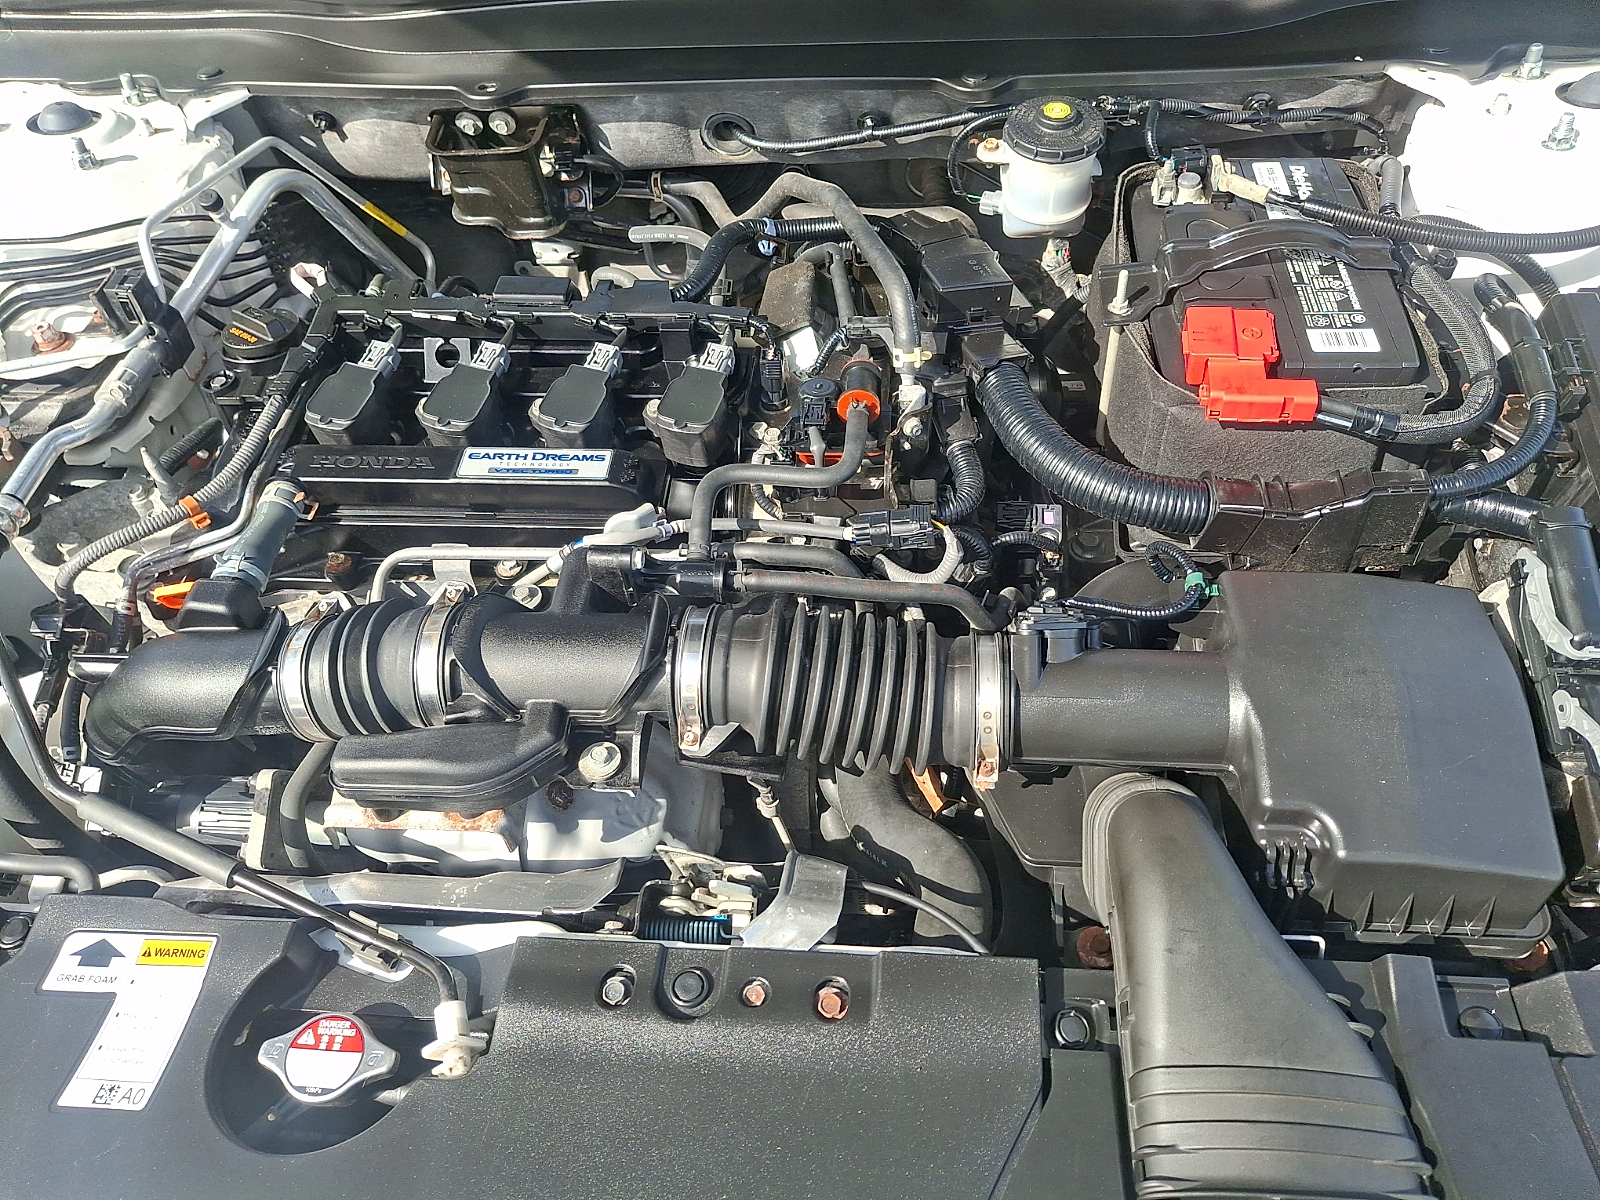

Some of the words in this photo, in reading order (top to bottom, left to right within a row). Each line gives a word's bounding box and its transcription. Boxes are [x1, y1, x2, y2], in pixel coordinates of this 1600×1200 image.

[309, 454, 436, 469] HONDA
[468, 452, 527, 460] EARTH
[531, 452, 607, 462] DREAMS
[154, 947, 206, 959] WARNING
[56, 973, 86, 983] GRAB
[88, 975, 118, 985] FOAM
[319, 1019, 352, 1029] DANGER
[317, 1027, 357, 1037] WARNING
[118, 1087, 146, 1105] A0
